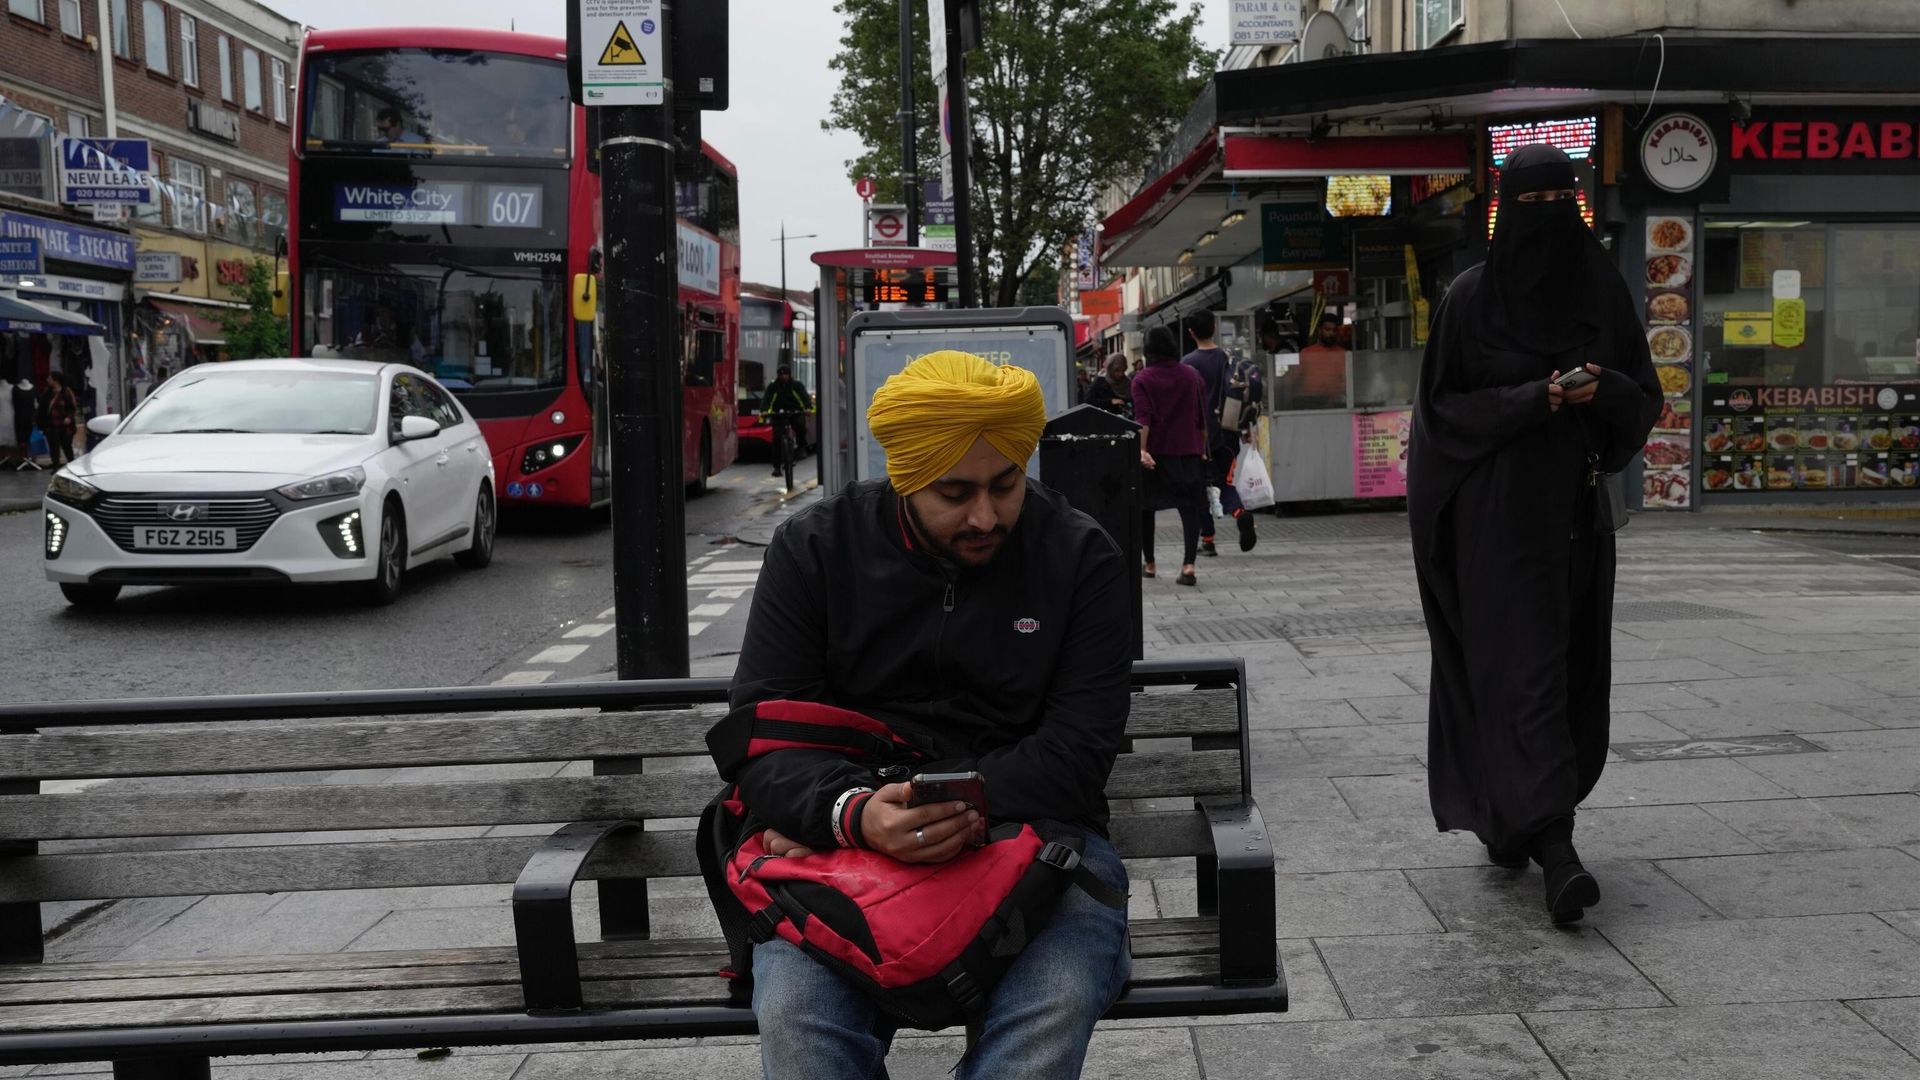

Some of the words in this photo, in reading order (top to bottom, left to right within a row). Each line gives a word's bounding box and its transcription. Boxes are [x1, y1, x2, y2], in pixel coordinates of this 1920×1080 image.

[1235, 2, 1268, 13] PARAM
[1272, 2, 1279, 12] &
[1238, 20, 1294, 28] ACCOUNTANTS
[1234, 32, 1251, 40] 081
[1255, 31, 1270, 39] 571
[1649, 120, 1709, 148] KEBABISH
[1731, 121, 1920, 160] KEBAB
[68, 173, 100, 185] NEW
[76, 189, 94, 198] 020
[861, 181, 871, 196] J
[344, 187, 406, 205] White
[411, 189, 452, 209] City
[492, 192, 535, 224] 607
[364, 211, 403, 220] LIMITED
[0, 242, 32, 253] NITH
[79, 234, 129, 263] EYECARE
[513, 252, 562, 263] VMH2594
[144, 263, 164, 271] LENS
[1757, 387, 1874, 406] KEBABISH
[145, 529, 180, 545] FGZ
[185, 530, 225, 546] 2515
